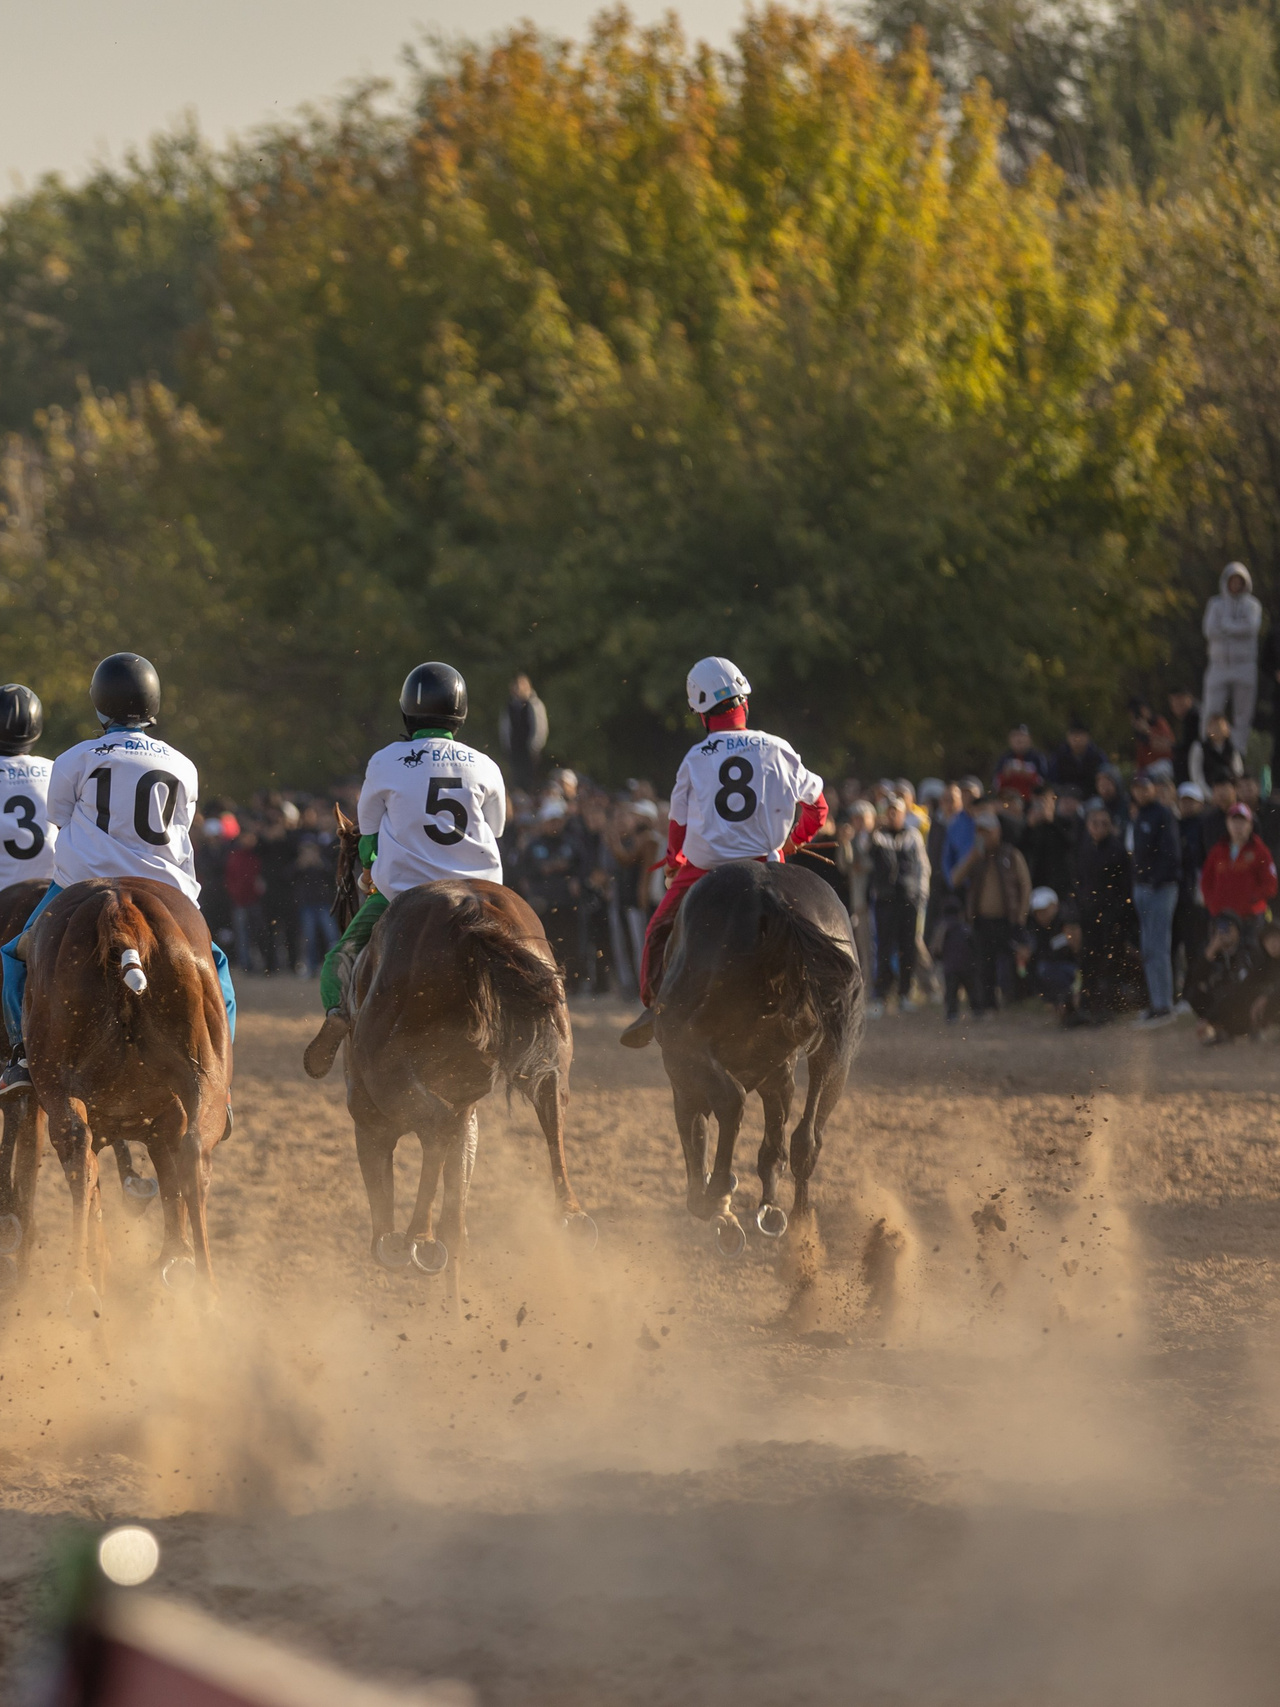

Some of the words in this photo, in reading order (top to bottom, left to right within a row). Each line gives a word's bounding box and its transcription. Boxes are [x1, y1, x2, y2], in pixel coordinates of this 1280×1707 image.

[124, 740, 170, 756] BAIGE
[432, 749, 475, 763] BAIGE
[726, 736, 769, 750] BAIGE
[8, 765, 48, 780] BAIGE
[714, 756, 757, 822] 8
[88, 768, 179, 846] 10
[423, 777, 468, 846] 5
[3, 795, 44, 860] 3
